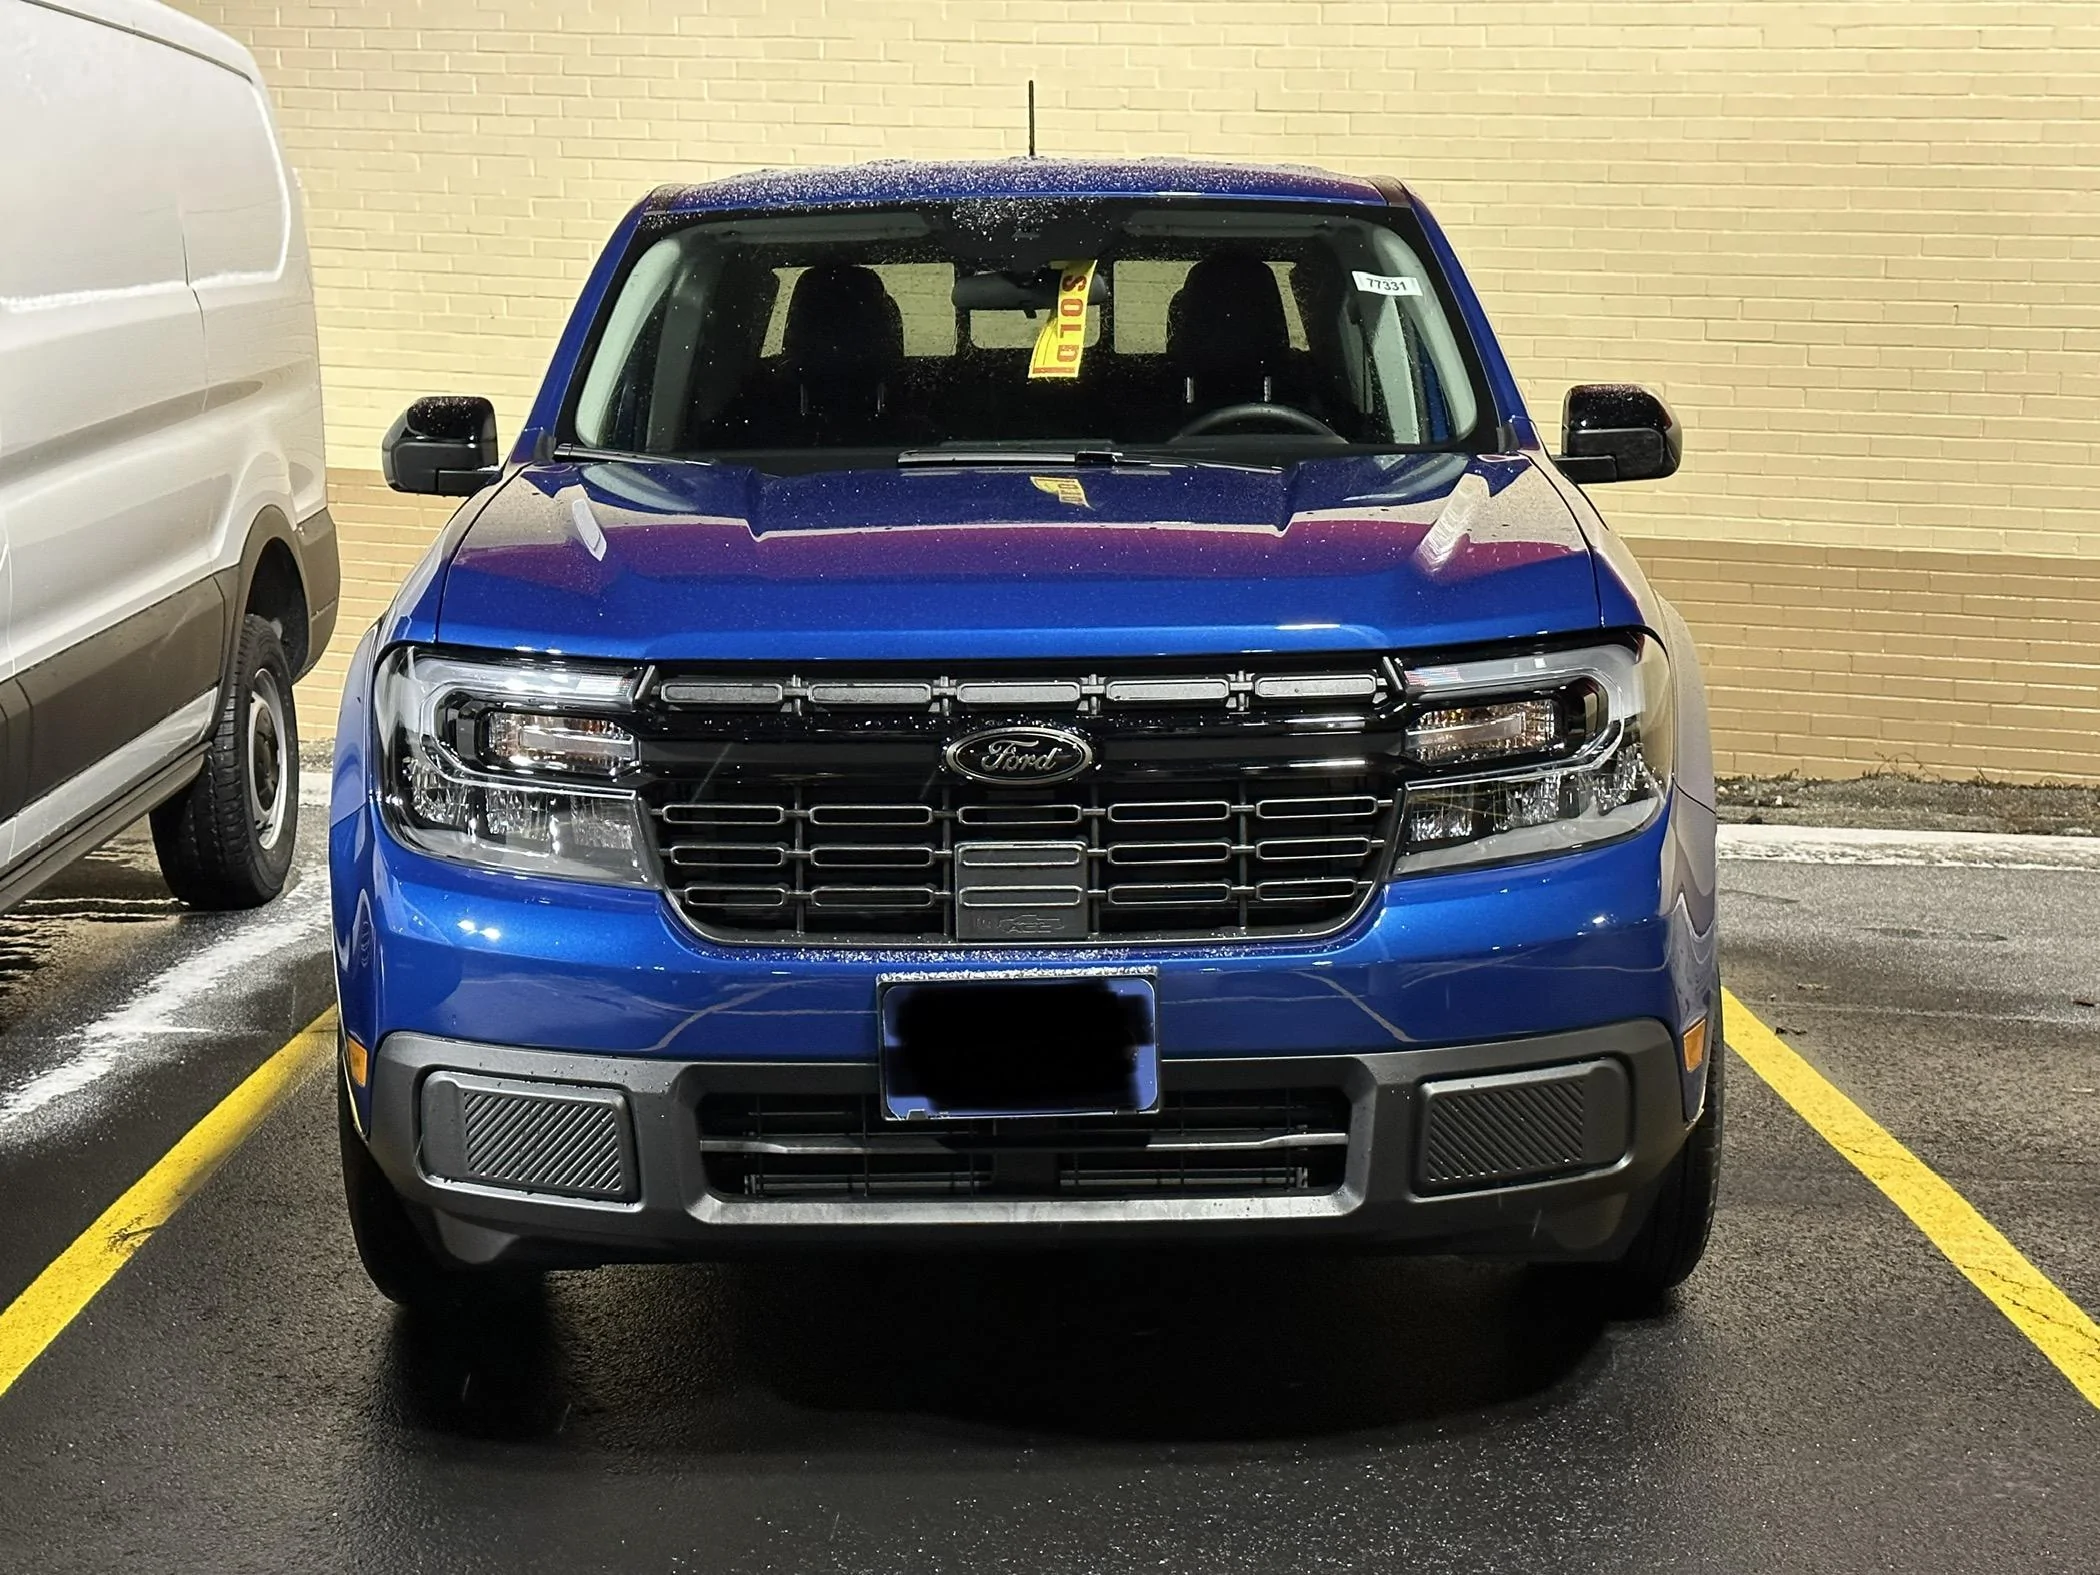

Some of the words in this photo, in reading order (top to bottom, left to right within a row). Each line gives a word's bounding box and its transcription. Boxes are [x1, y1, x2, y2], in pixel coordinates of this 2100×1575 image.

[1366, 277, 1407, 292] 77331
[1057, 275, 1087, 362] SOLD
[981, 739, 1057, 771] Ford
